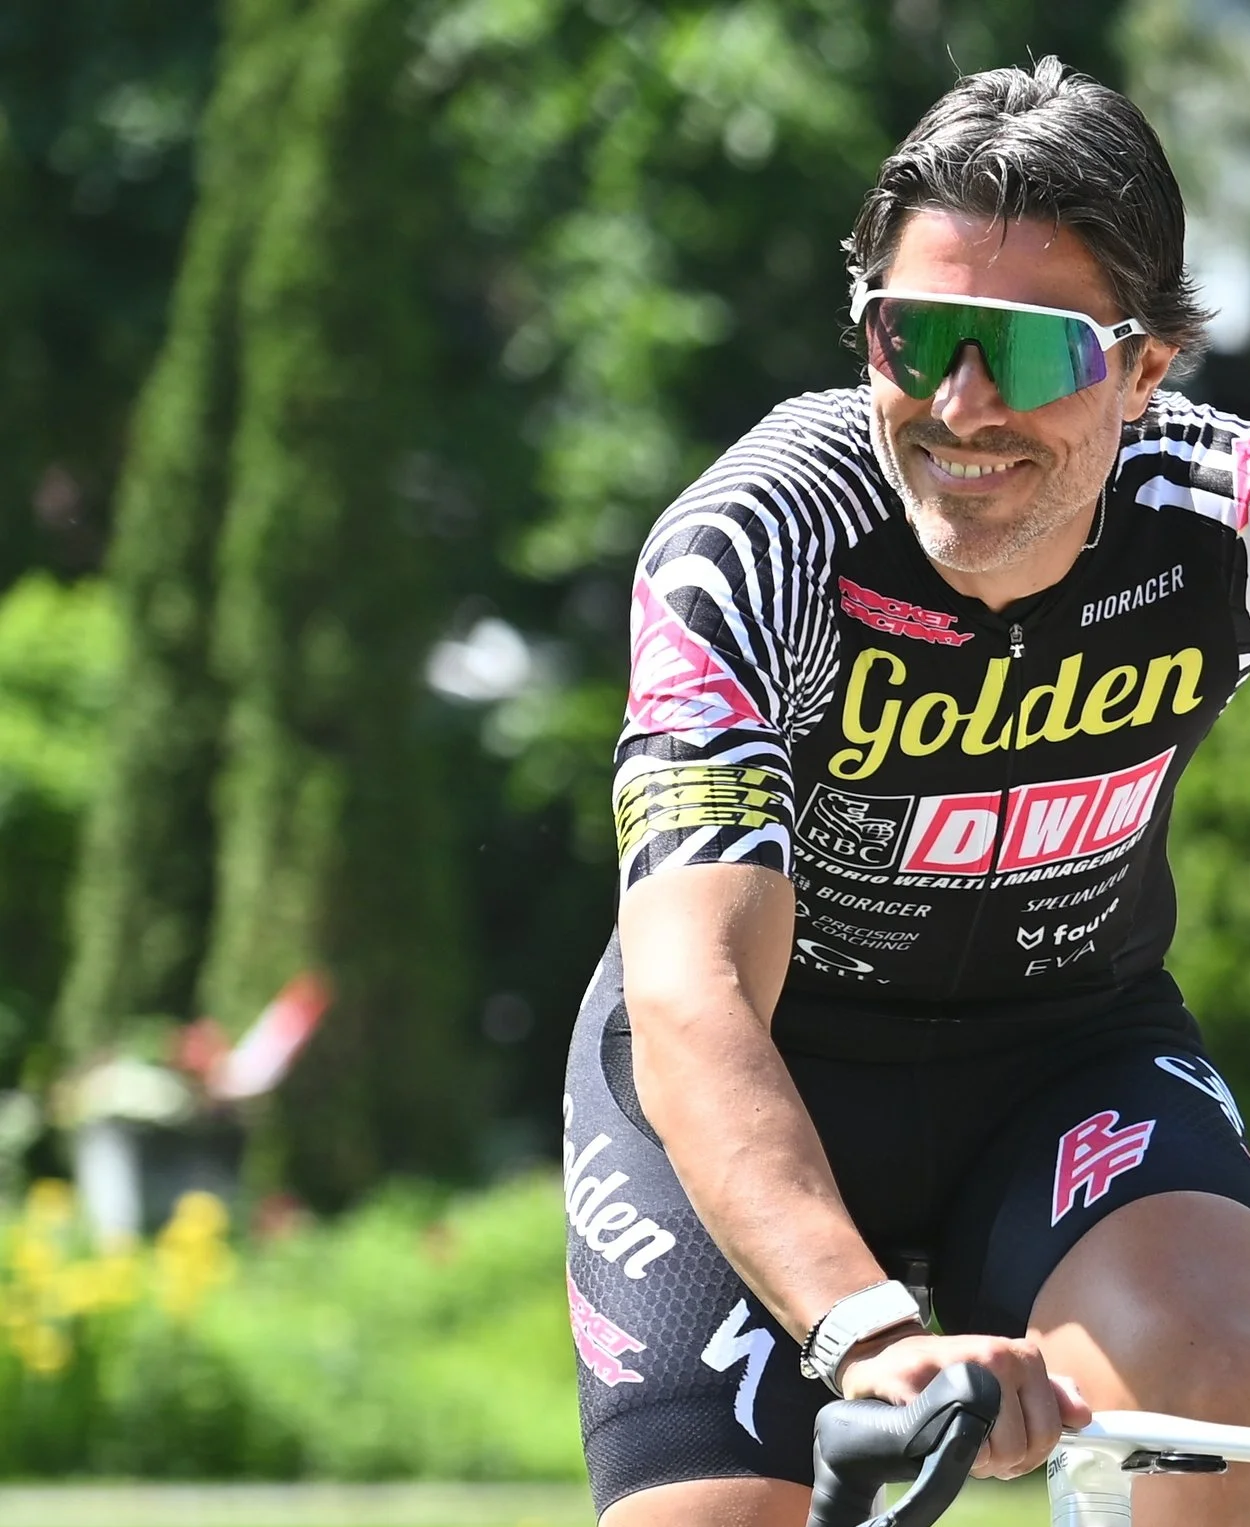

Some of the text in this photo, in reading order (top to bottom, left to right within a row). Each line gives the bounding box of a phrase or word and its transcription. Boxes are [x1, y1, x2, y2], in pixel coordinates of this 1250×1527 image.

[1081, 564, 1185, 627] BIORACER
[923, 773, 1158, 865] DWM
[808, 826, 886, 864] RBC
[815, 860, 890, 884] IORIO
[1003, 823, 1149, 887] MANAGEMENT
[816, 886, 932, 918] BIORACER
[812, 921, 912, 951] COACHING
[818, 915, 920, 941] PRECISION
[1053, 898, 1119, 945] fauve
[1025, 940, 1096, 976] EVA
